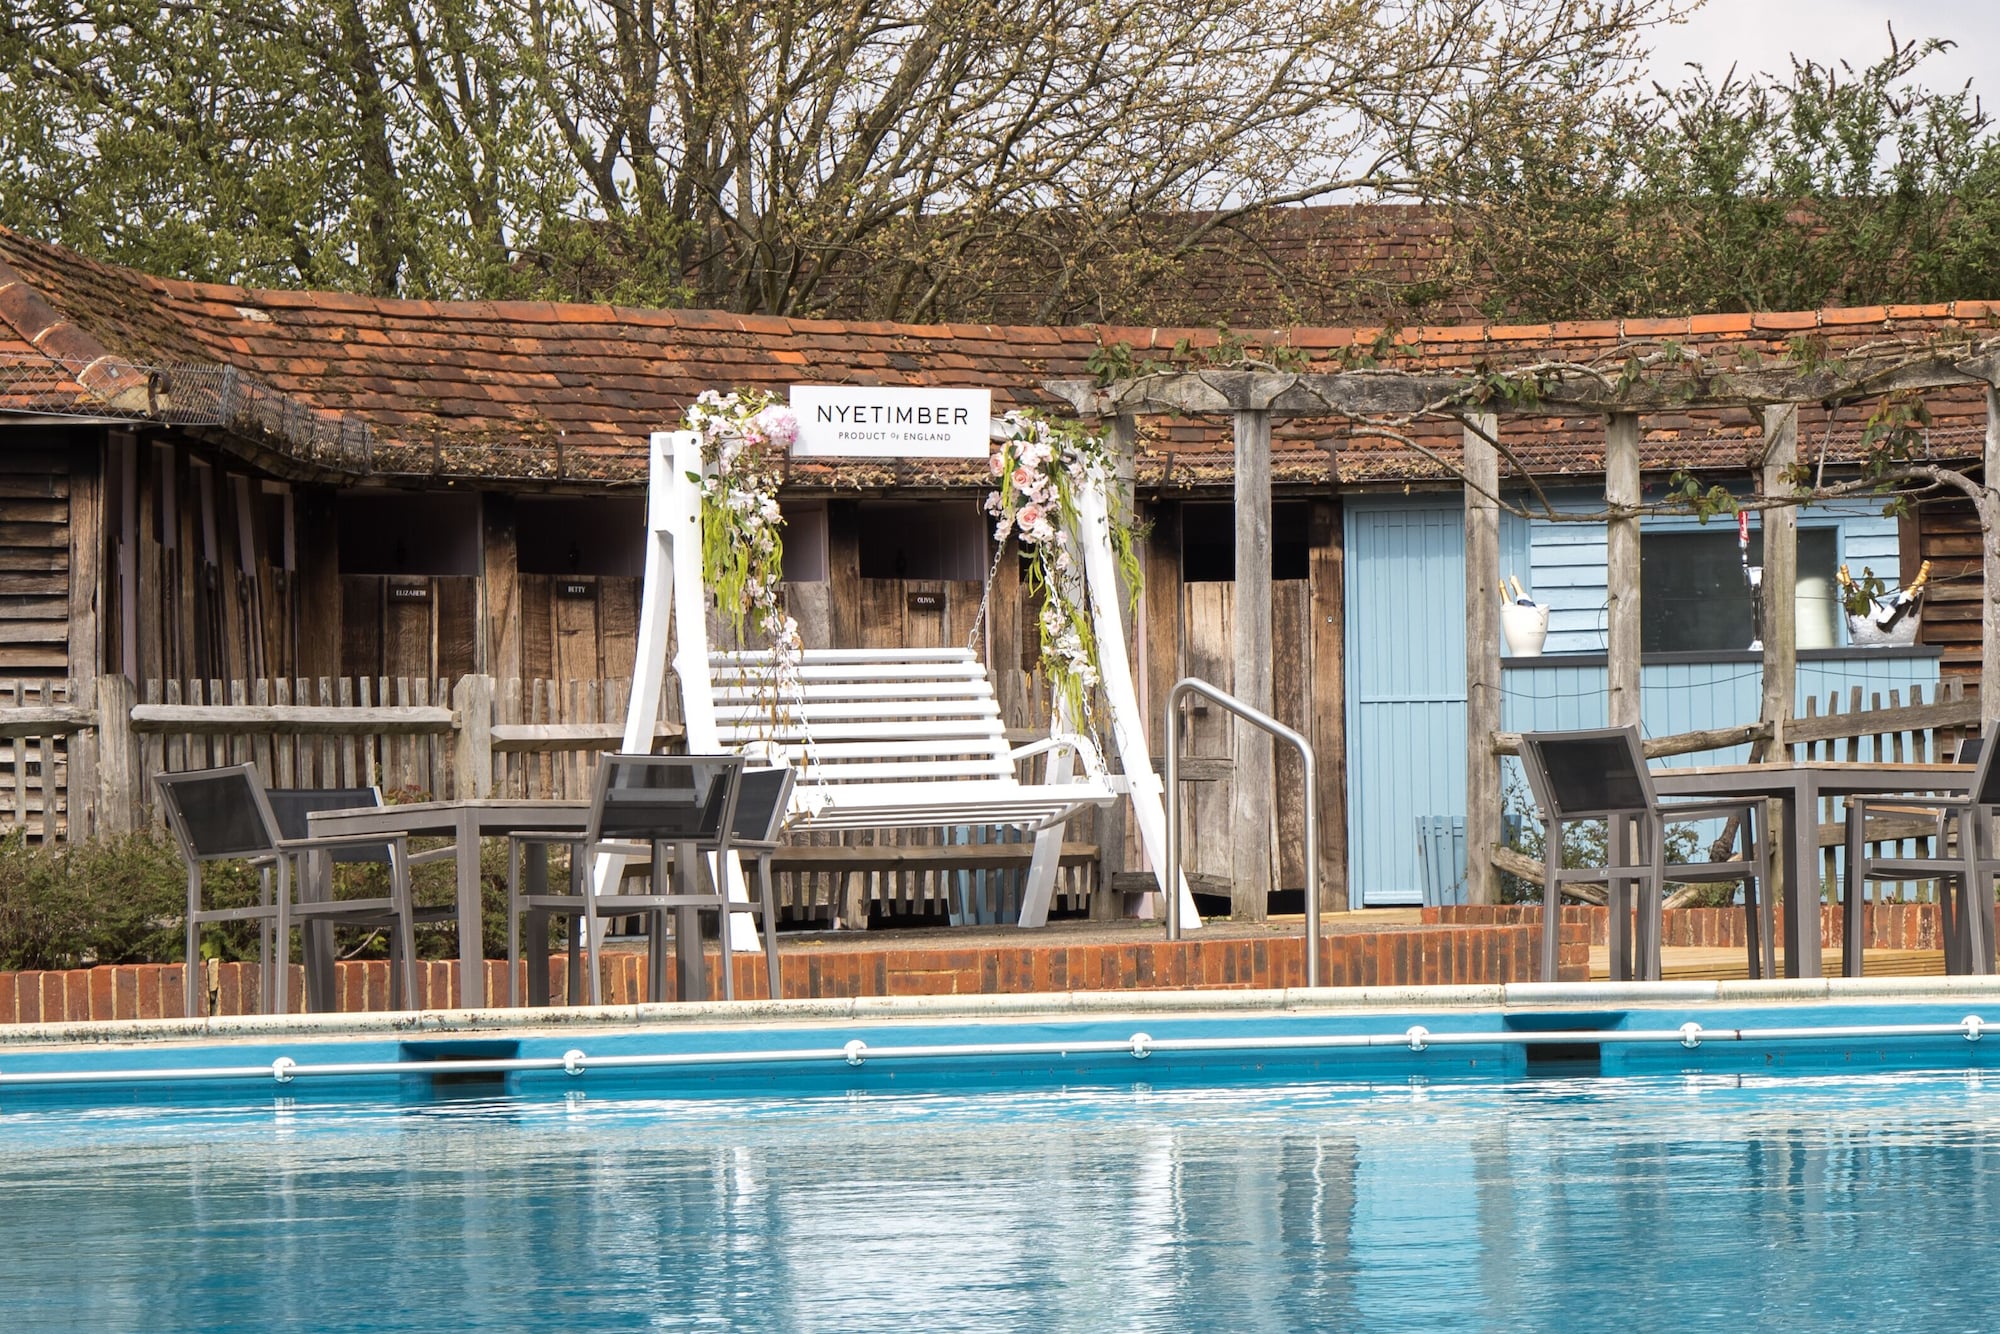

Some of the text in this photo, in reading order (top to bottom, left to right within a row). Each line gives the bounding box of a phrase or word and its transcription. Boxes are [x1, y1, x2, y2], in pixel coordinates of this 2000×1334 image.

[817, 405, 968, 425] NYETIMBER
[838, 432, 886, 441] PRODUCT
[903, 432, 951, 441] ENGLAND
[395, 589, 427, 597] ELIZABETH
[567, 585, 586, 593] BETTY
[916, 596, 936, 604] OLIVIA
